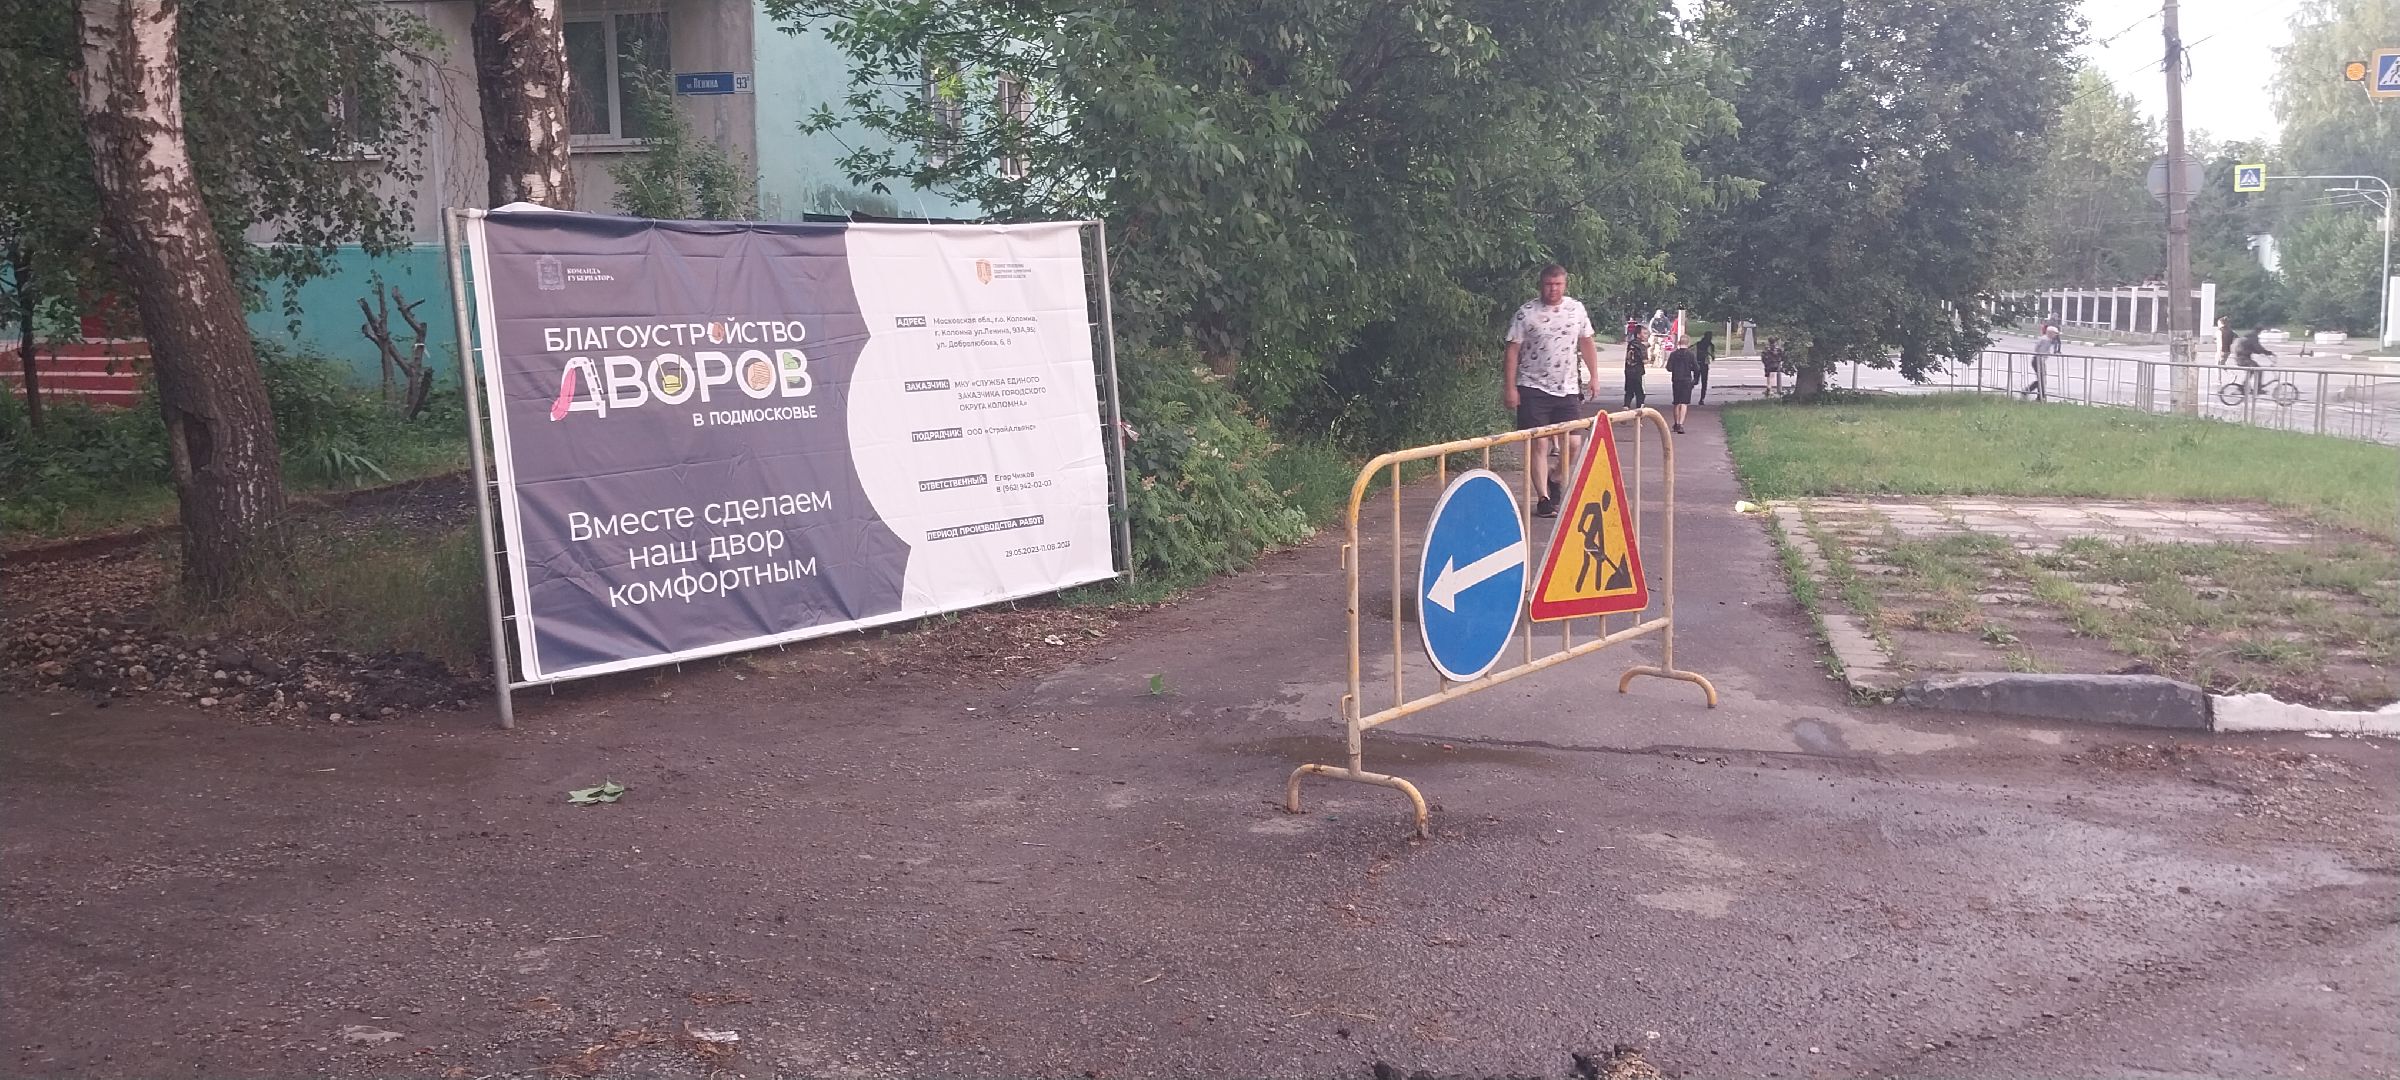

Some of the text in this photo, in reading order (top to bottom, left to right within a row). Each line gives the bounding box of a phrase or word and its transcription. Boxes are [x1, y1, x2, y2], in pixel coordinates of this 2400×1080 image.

[933, 316, 976, 325] Московская
[544, 316, 806, 352] БЛАГОУСТРОЙСТВО
[550, 349, 813, 422] ДВОРОВ
[905, 380, 950, 391] ЗАКАЗЧИК:
[1007, 376, 1040, 385] ЕДИНОГО
[958, 386, 1047, 400] ЗАКАЗЧИКА ГОРОДСКОГО
[693, 404, 818, 426] В ПОДМОСКОВЬЕ
[959, 403, 987, 412] ОКРУГА
[912, 428, 962, 441] ПОДРЯДЧИК:
[919, 474, 987, 491] ОТВЕТСТВЕННЫЙ:
[994, 473, 1012, 482] Егор
[568, 490, 833, 542] Вместе сделаем
[927, 516, 1044, 541] ПЕРИОД ПРОИЗВОДСТВА РАБОТ:
[629, 528, 785, 570] наш двор
[607, 556, 817, 608] комфортным
